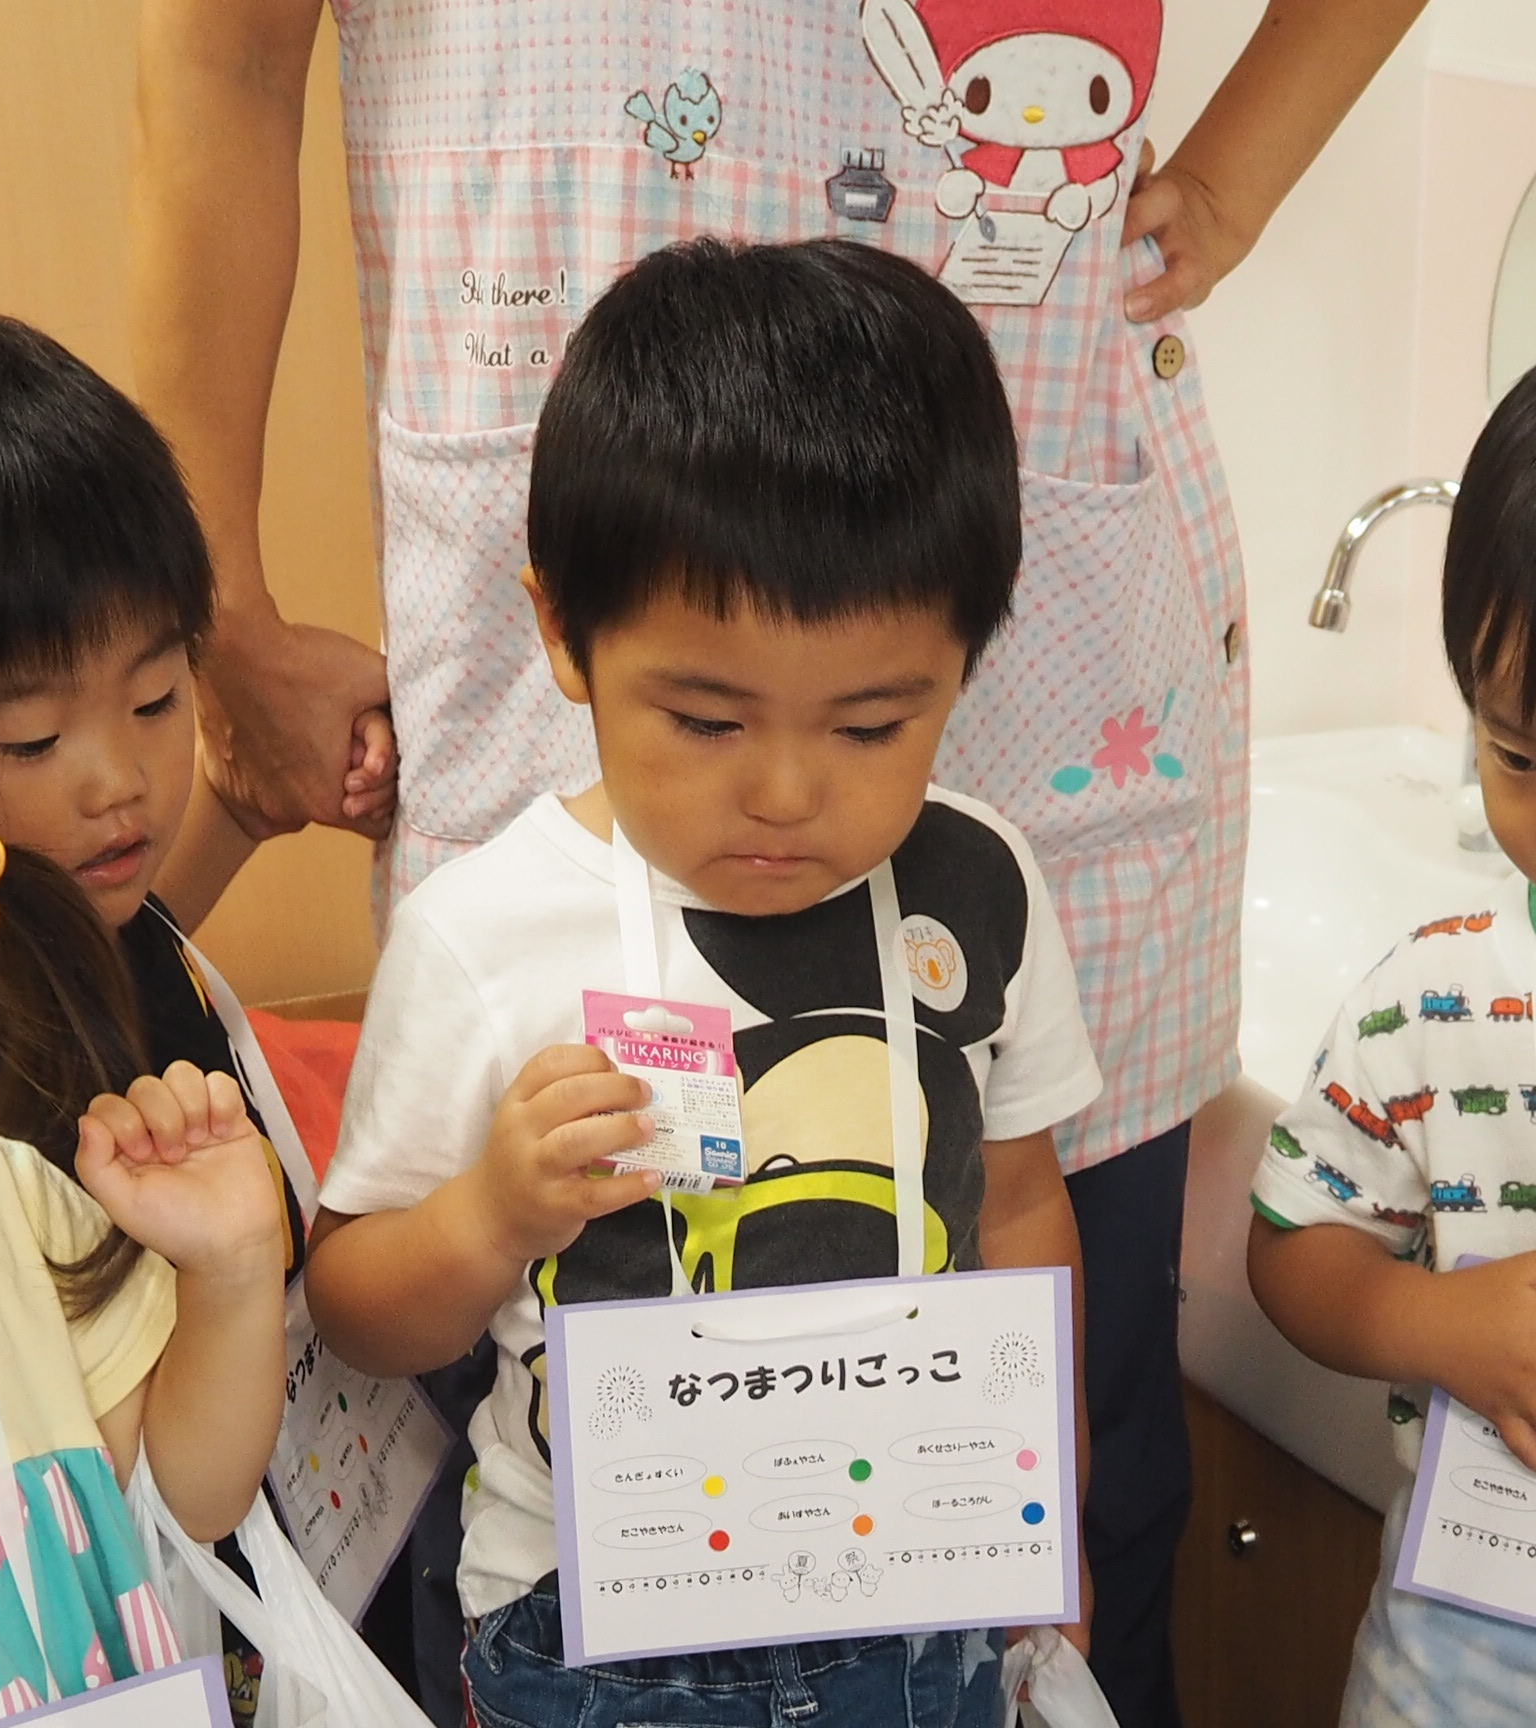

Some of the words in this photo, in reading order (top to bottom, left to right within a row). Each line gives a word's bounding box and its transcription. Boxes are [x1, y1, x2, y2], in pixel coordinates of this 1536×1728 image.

[464, 332, 513, 367] What
[530, 349, 550, 365] a
[617, 1041, 707, 1065] HIKARING
[633, 1057, 692, 1070] ヒカリング
[286, 1331, 323, 1404] なつまつ
[668, 1349, 962, 1408] なつまつりごっこ
[917, 1439, 995, 1454] あくせさりーやさん
[614, 1468, 684, 1483] きんぎょすくい
[1472, 1478, 1528, 1501] たこやきやさん
[932, 1495, 993, 1509] ぼーるころがし
[777, 1507, 831, 1521] あいすやさん
[621, 1523, 685, 1538] たこやきやさん
